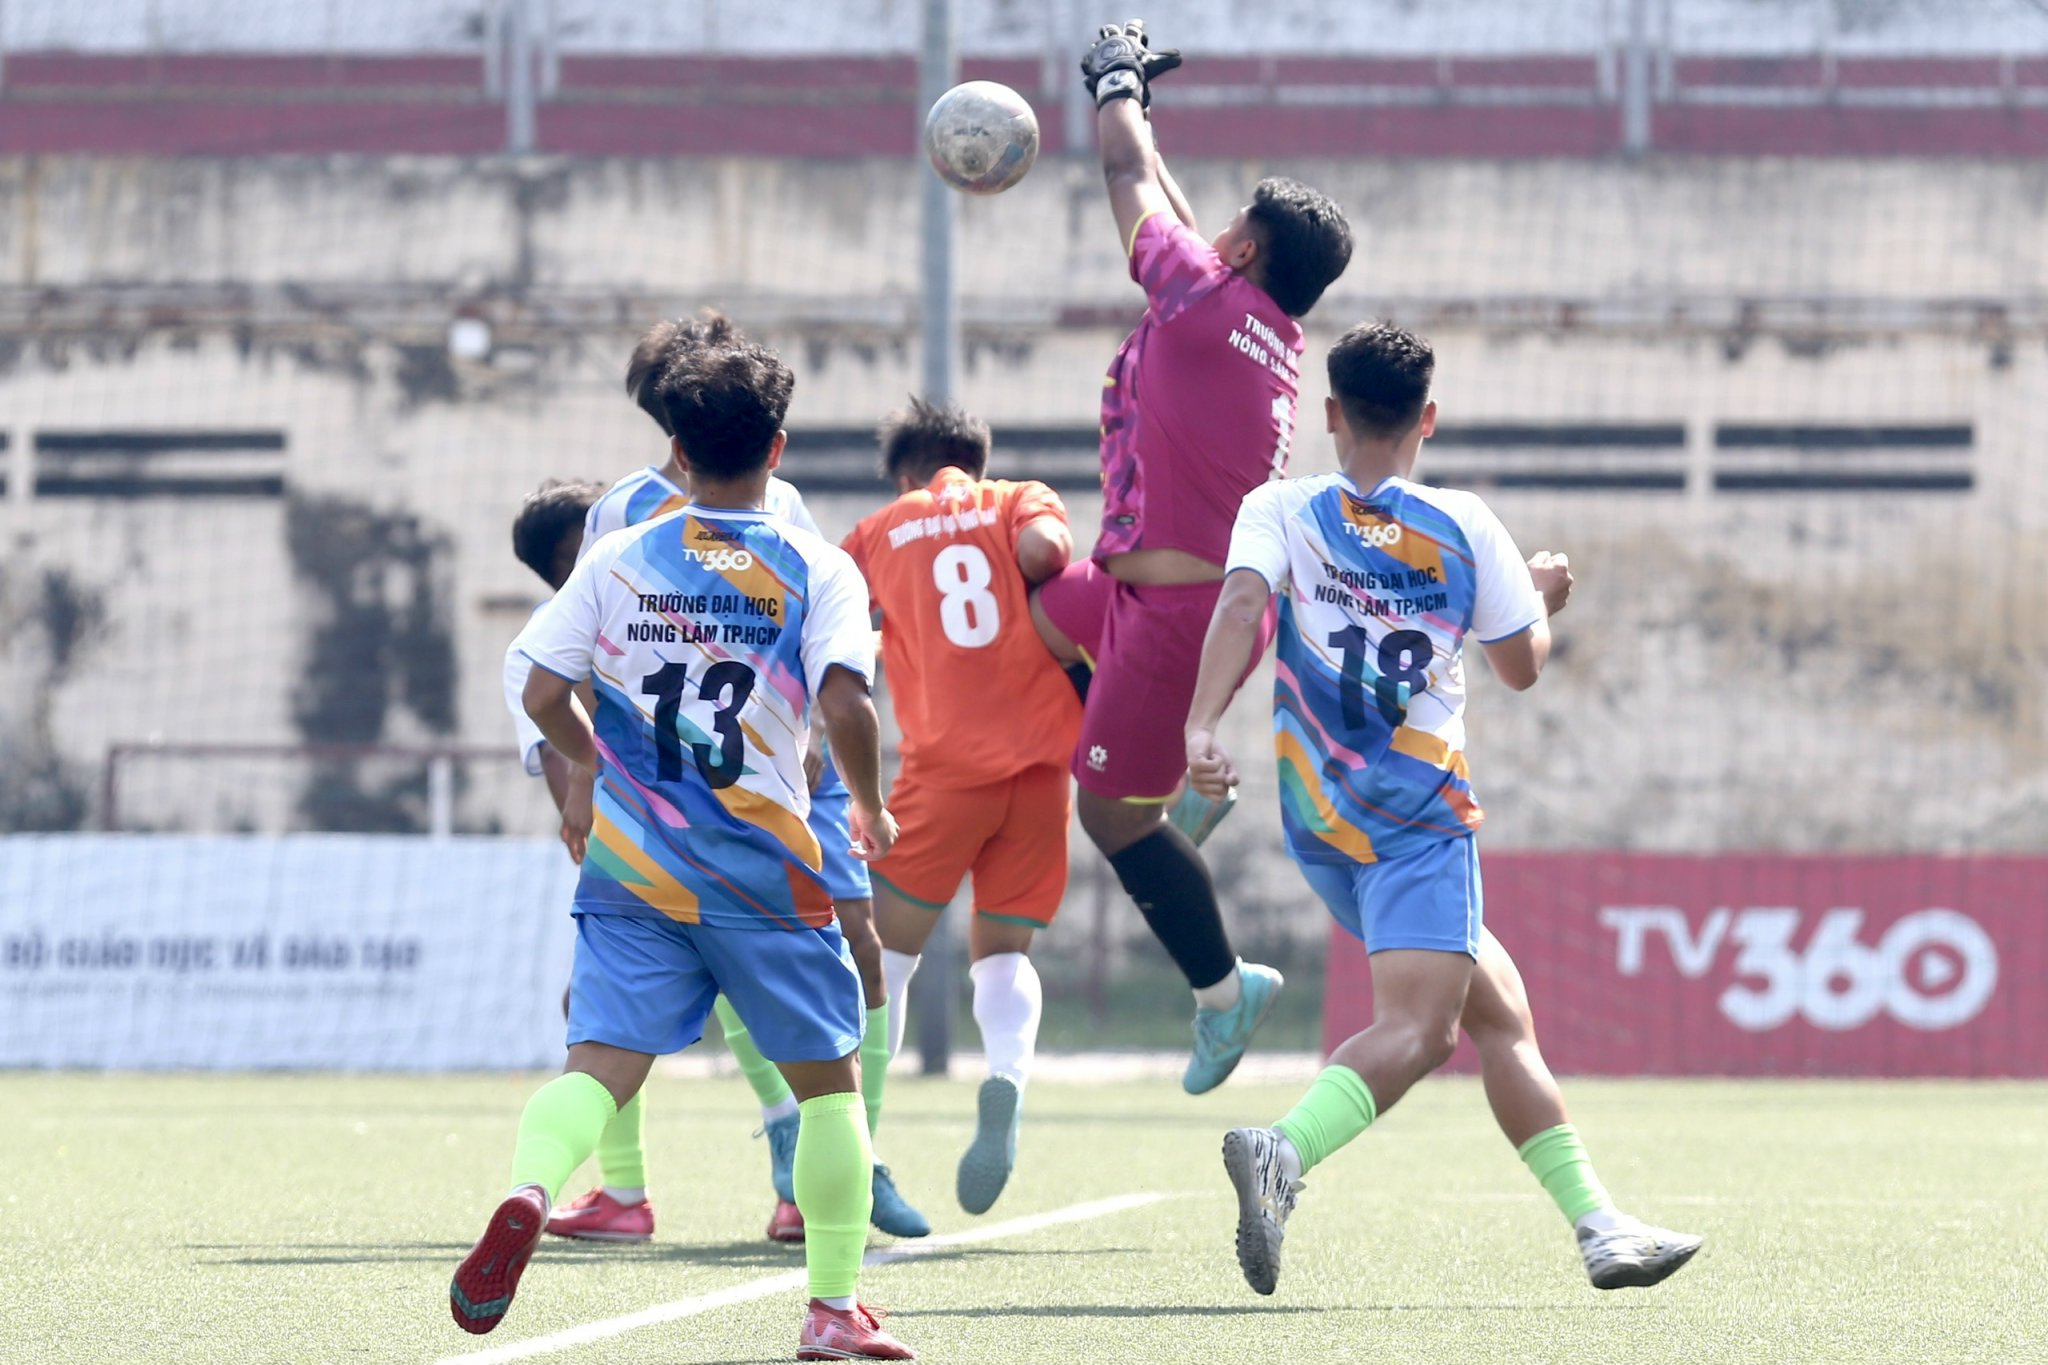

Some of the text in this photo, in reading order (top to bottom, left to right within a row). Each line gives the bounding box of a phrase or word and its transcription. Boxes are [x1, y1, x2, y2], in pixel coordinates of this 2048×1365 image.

[1228, 329, 1268, 366] NÔNG
[1341, 522, 1402, 548] TV360
[682, 548, 753, 571] TV360
[1380, 572, 1405, 593] ĐẠI
[1407, 566, 1438, 590] HỌC
[638, 591, 778, 620] TRƯỜNG ĐẠI HỌC
[933, 544, 1000, 648] 8
[1394, 592, 1448, 616] TP.HCM
[627, 620, 783, 646] NÔNG LÂM TP.HCM
[1328, 624, 1434, 731] 18
[641, 660, 757, 789] 13
[1599, 906, 1998, 1032] TV360
